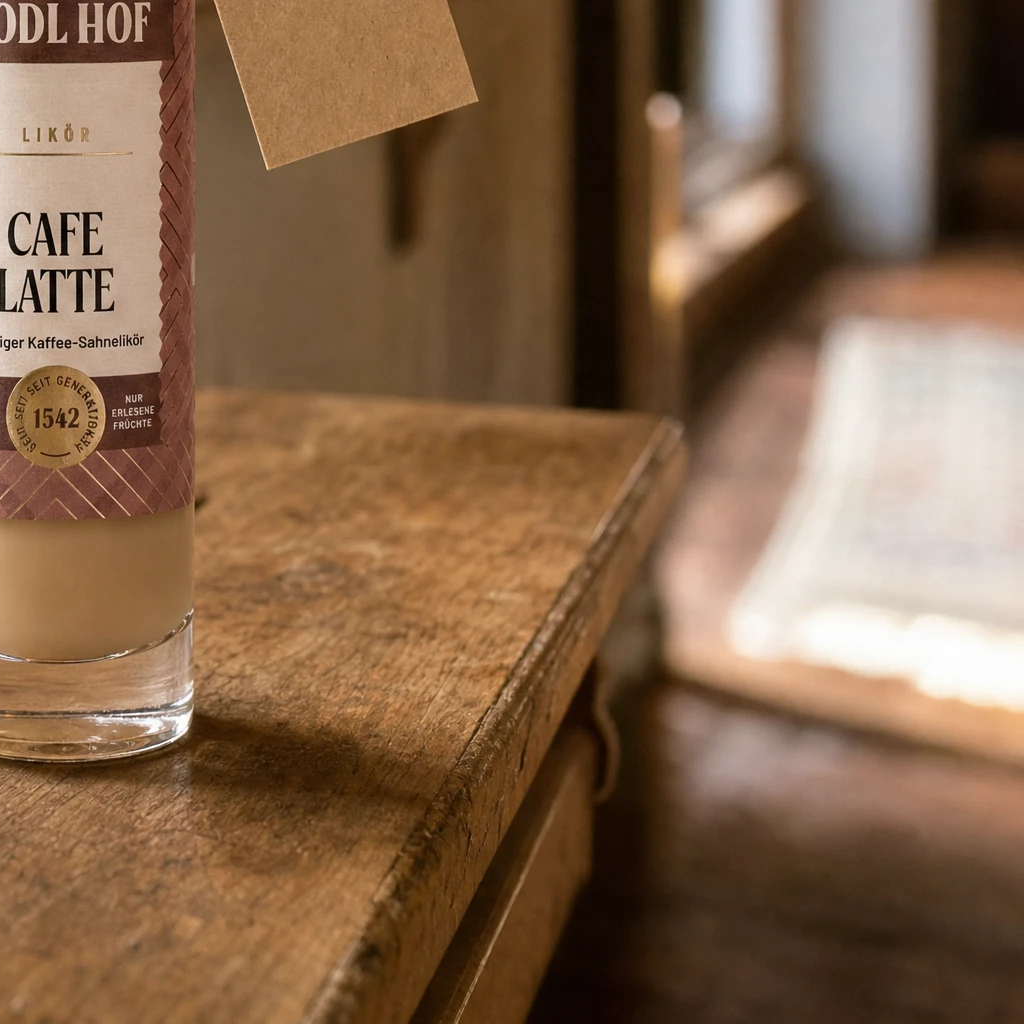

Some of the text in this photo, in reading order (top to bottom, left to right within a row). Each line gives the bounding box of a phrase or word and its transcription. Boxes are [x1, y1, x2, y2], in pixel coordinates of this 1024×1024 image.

[77, 1, 151, 44] HOF
[22, 124, 90, 143] LIKÖR
[7, 211, 104, 256] CAFE
[28, 333, 144, 349] Kaffee-Sahnelikör
[27, 376, 51, 396] SEIT
[125, 394, 143, 404] NUR
[33, 407, 80, 429] 1542
[111, 405, 155, 418] ERLESENE
